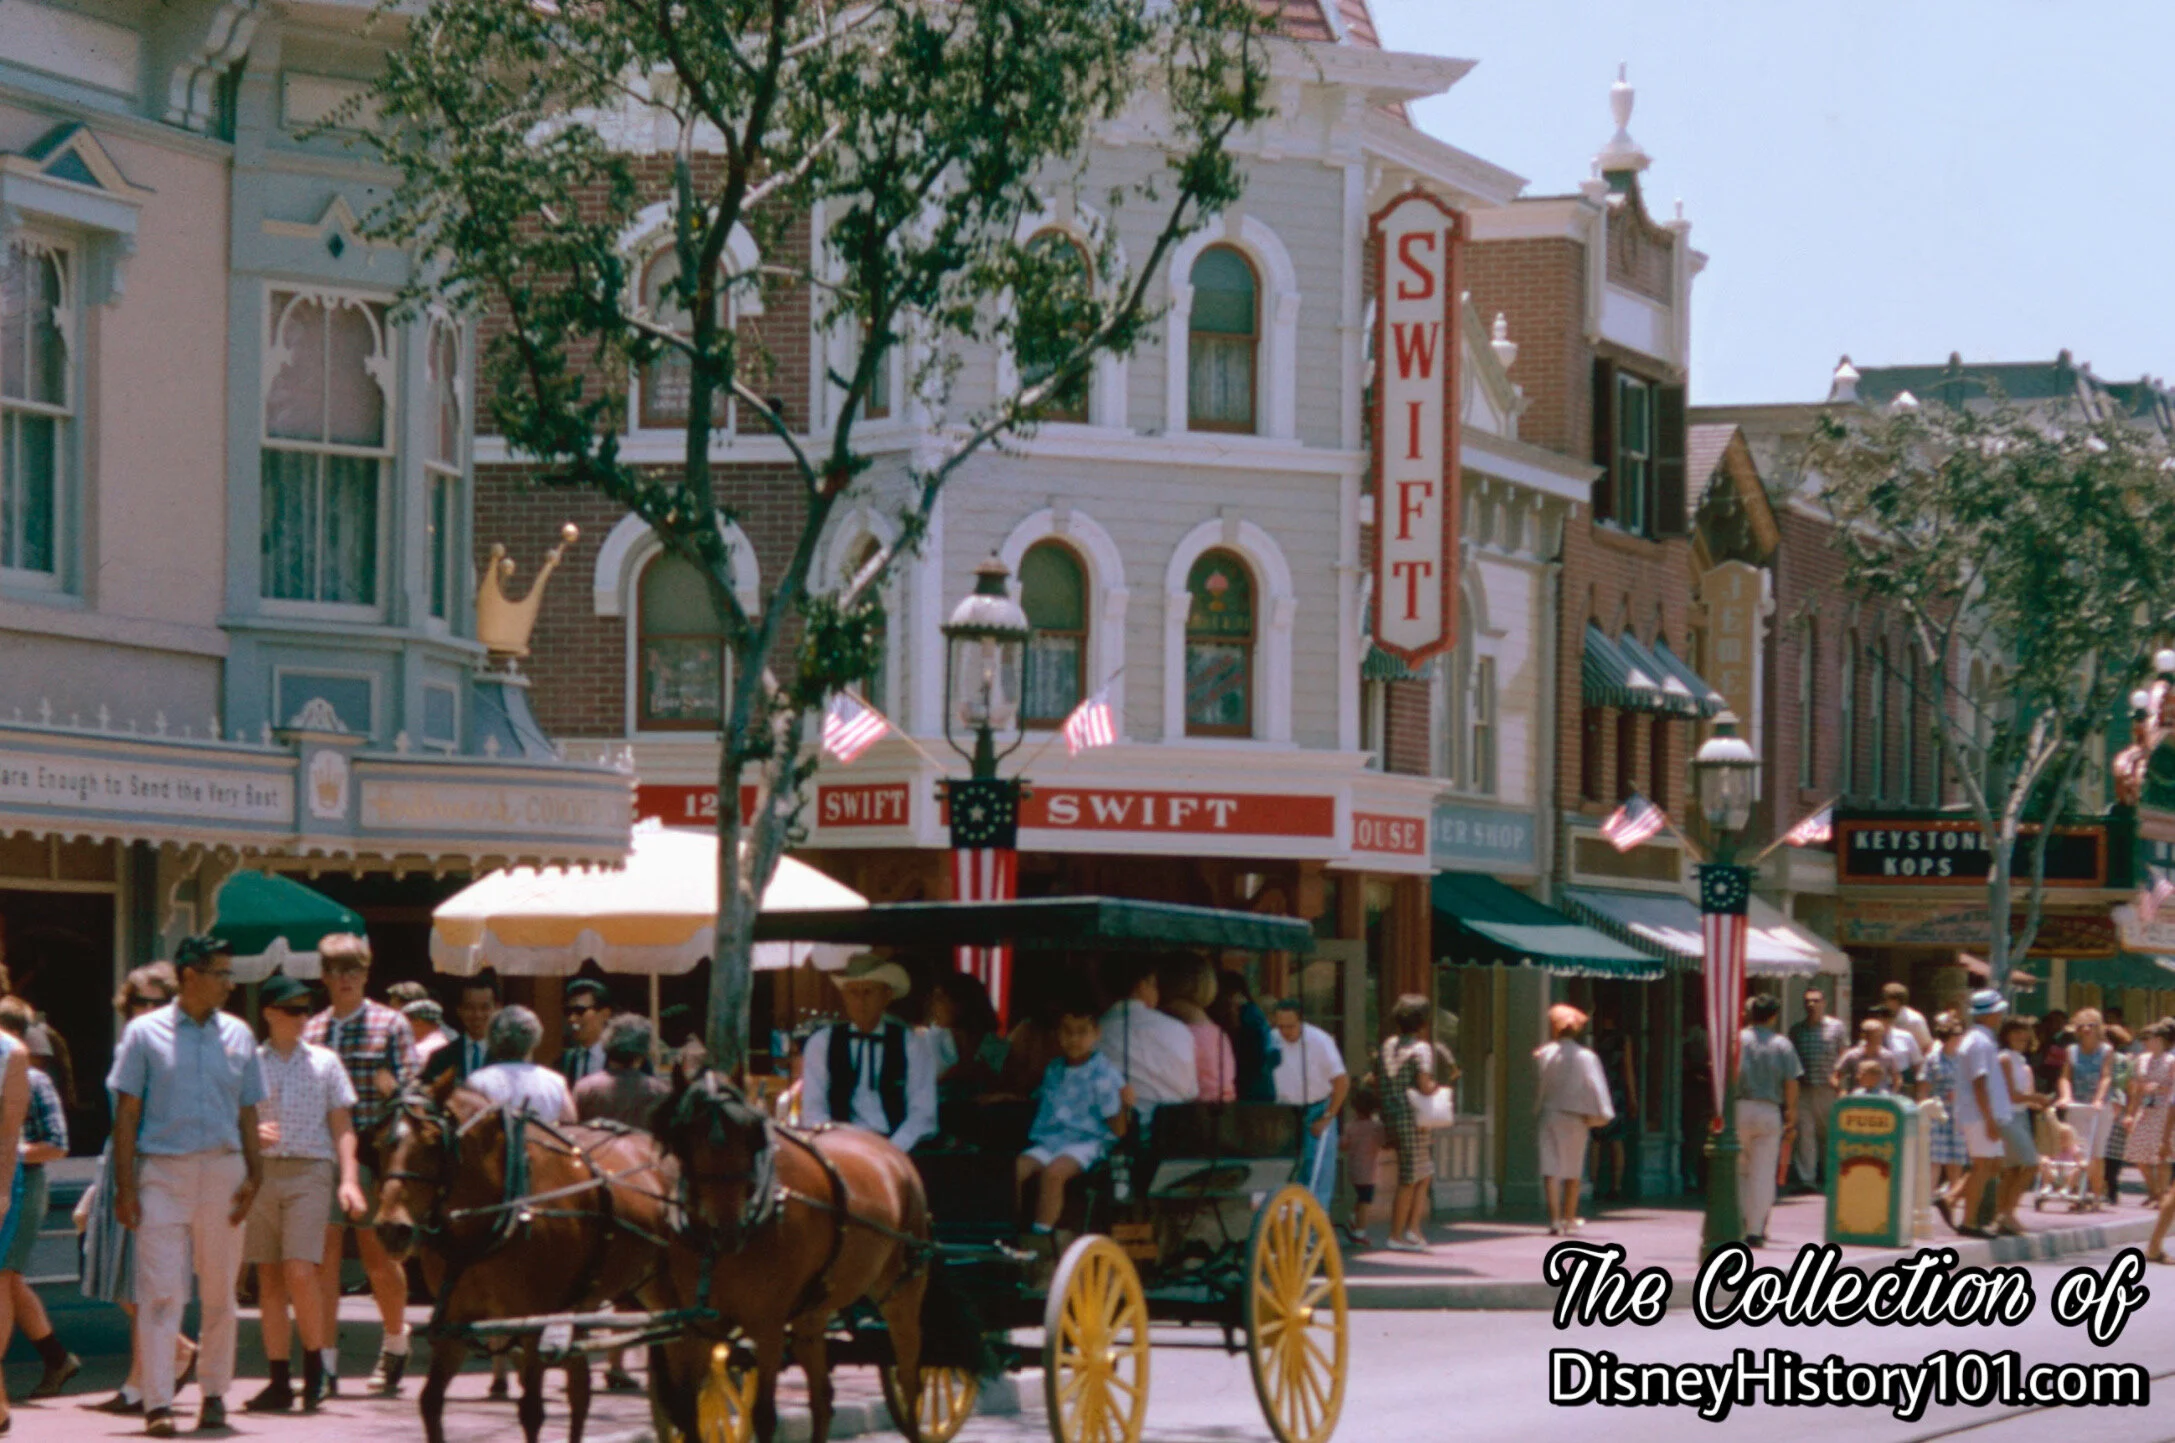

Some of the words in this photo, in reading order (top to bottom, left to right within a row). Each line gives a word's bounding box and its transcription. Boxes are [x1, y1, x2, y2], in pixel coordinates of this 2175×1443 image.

[1391, 232, 1441, 620] SWIFT
[38, 765, 98, 801] Enough
[105, 773, 122, 795] to
[131, 774, 169, 800] Send
[177, 778, 201, 802] the
[207, 781, 238, 808] Very
[246, 783, 278, 807] Best
[825, 789, 905, 821] SWIFT
[1047, 794, 1238, 828] SWIFT
[1352, 817, 1417, 850] OUSE
[1473, 822, 1525, 850] SHOP
[1884, 857, 1953, 877] KOPS
